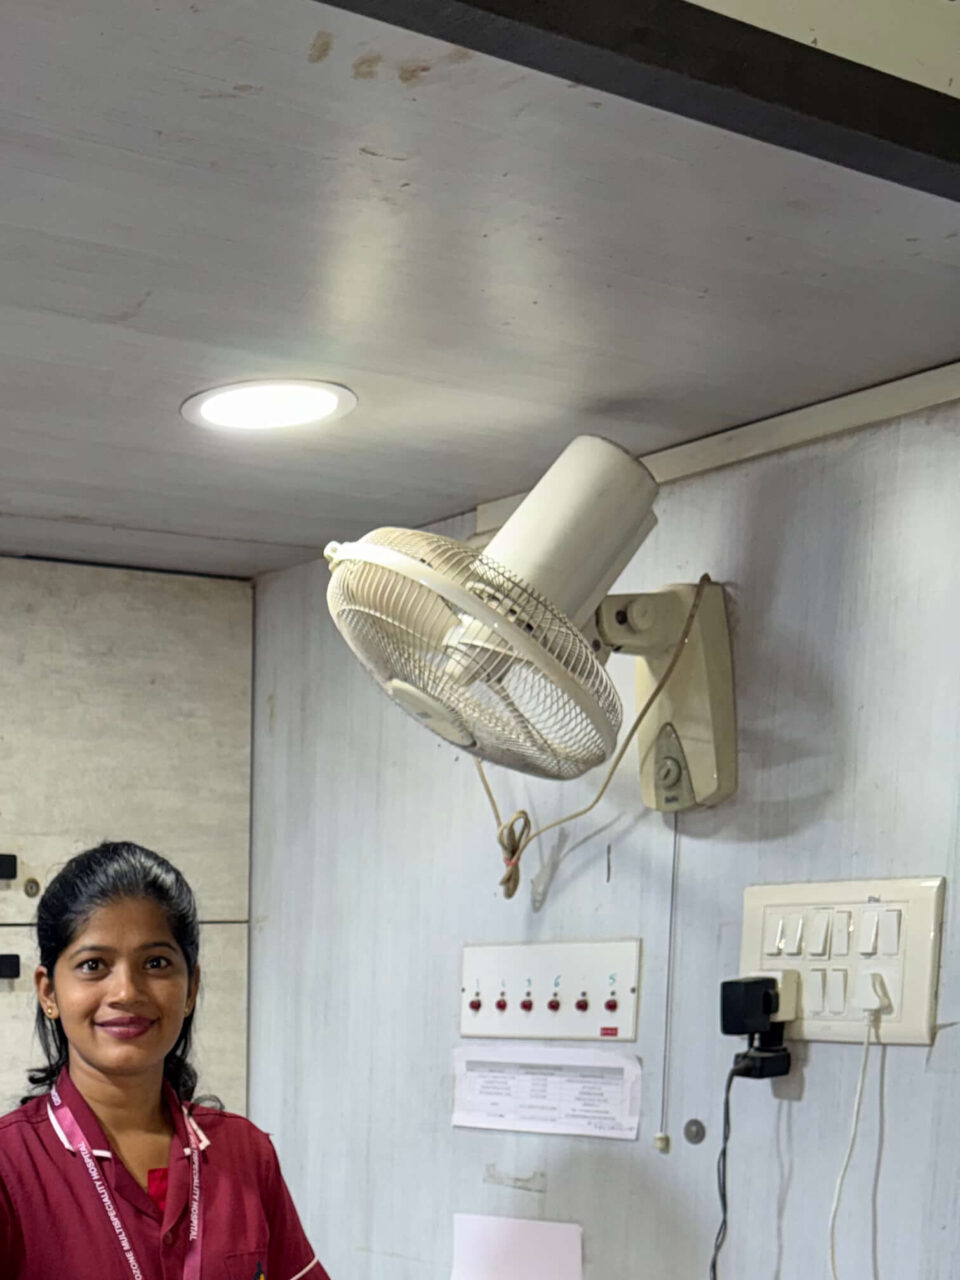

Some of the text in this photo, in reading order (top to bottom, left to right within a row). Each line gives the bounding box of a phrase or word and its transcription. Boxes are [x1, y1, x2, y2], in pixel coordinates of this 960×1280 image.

[77, 1140, 99, 1180] HOSPITAL
[93, 1180, 131, 1251] MULTISPECIALITY
[190, 1199, 201, 1241] HOSPITAL
